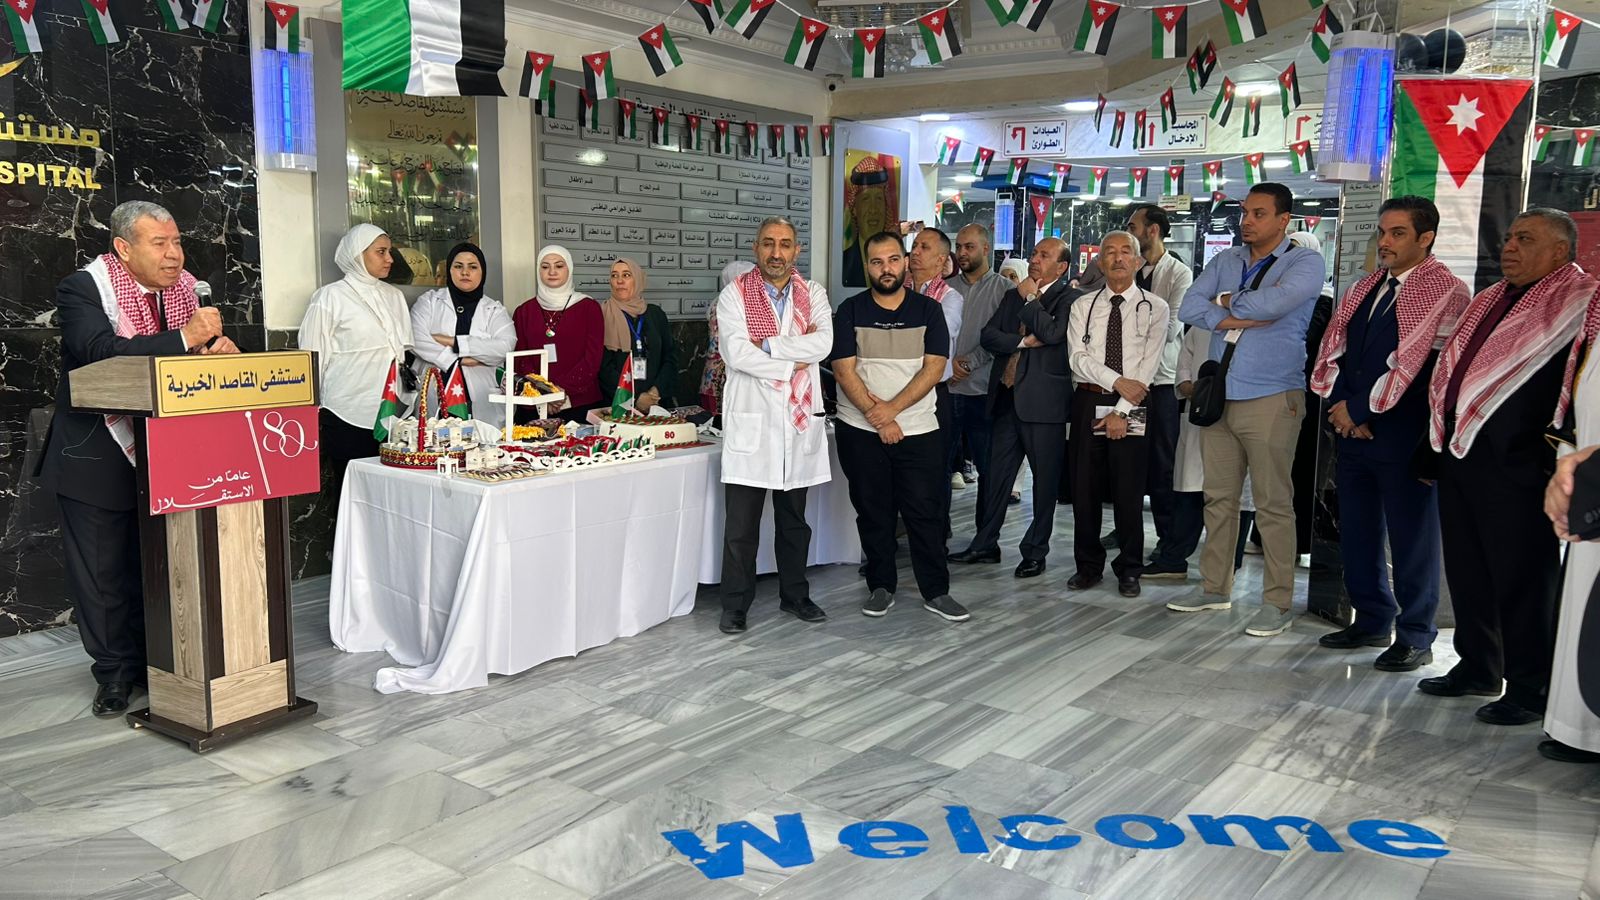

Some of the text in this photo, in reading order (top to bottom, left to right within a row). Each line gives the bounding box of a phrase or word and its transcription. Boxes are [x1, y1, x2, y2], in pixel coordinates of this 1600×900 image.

[1032, 126, 1061, 135] العيادات
[1171, 119, 1199, 129] المحاسب
[1031, 139, 1061, 150] الطوارئ
[0, 161, 102, 190] SPITAL
[166, 367, 306, 398] مستشفى المقاصد الخيرية
[664, 431, 675, 439] 80
[188, 475, 223, 490] من
[661, 805, 1450, 881] Welcome
